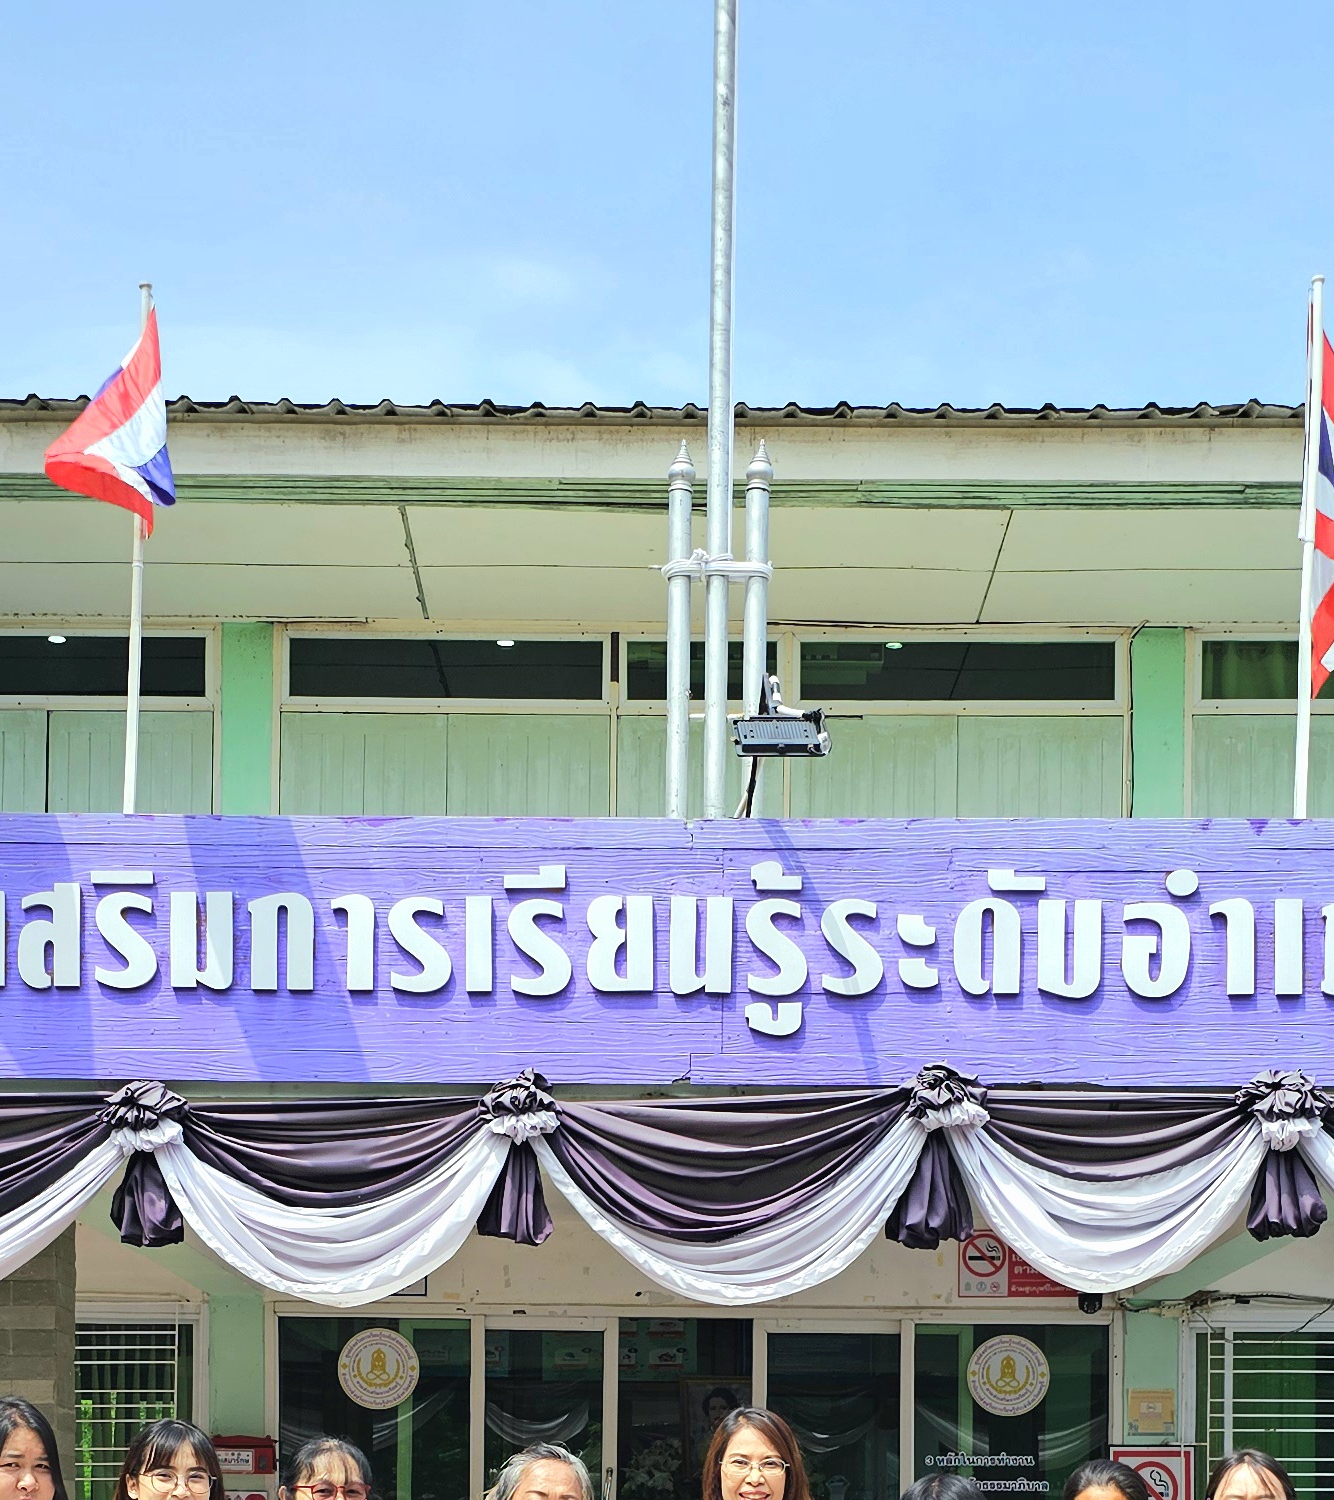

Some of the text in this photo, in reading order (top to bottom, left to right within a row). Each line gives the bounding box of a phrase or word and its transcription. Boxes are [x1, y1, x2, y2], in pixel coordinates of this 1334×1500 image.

[925, 1452, 1036, 1467] 3 หลักในการทำงาน
